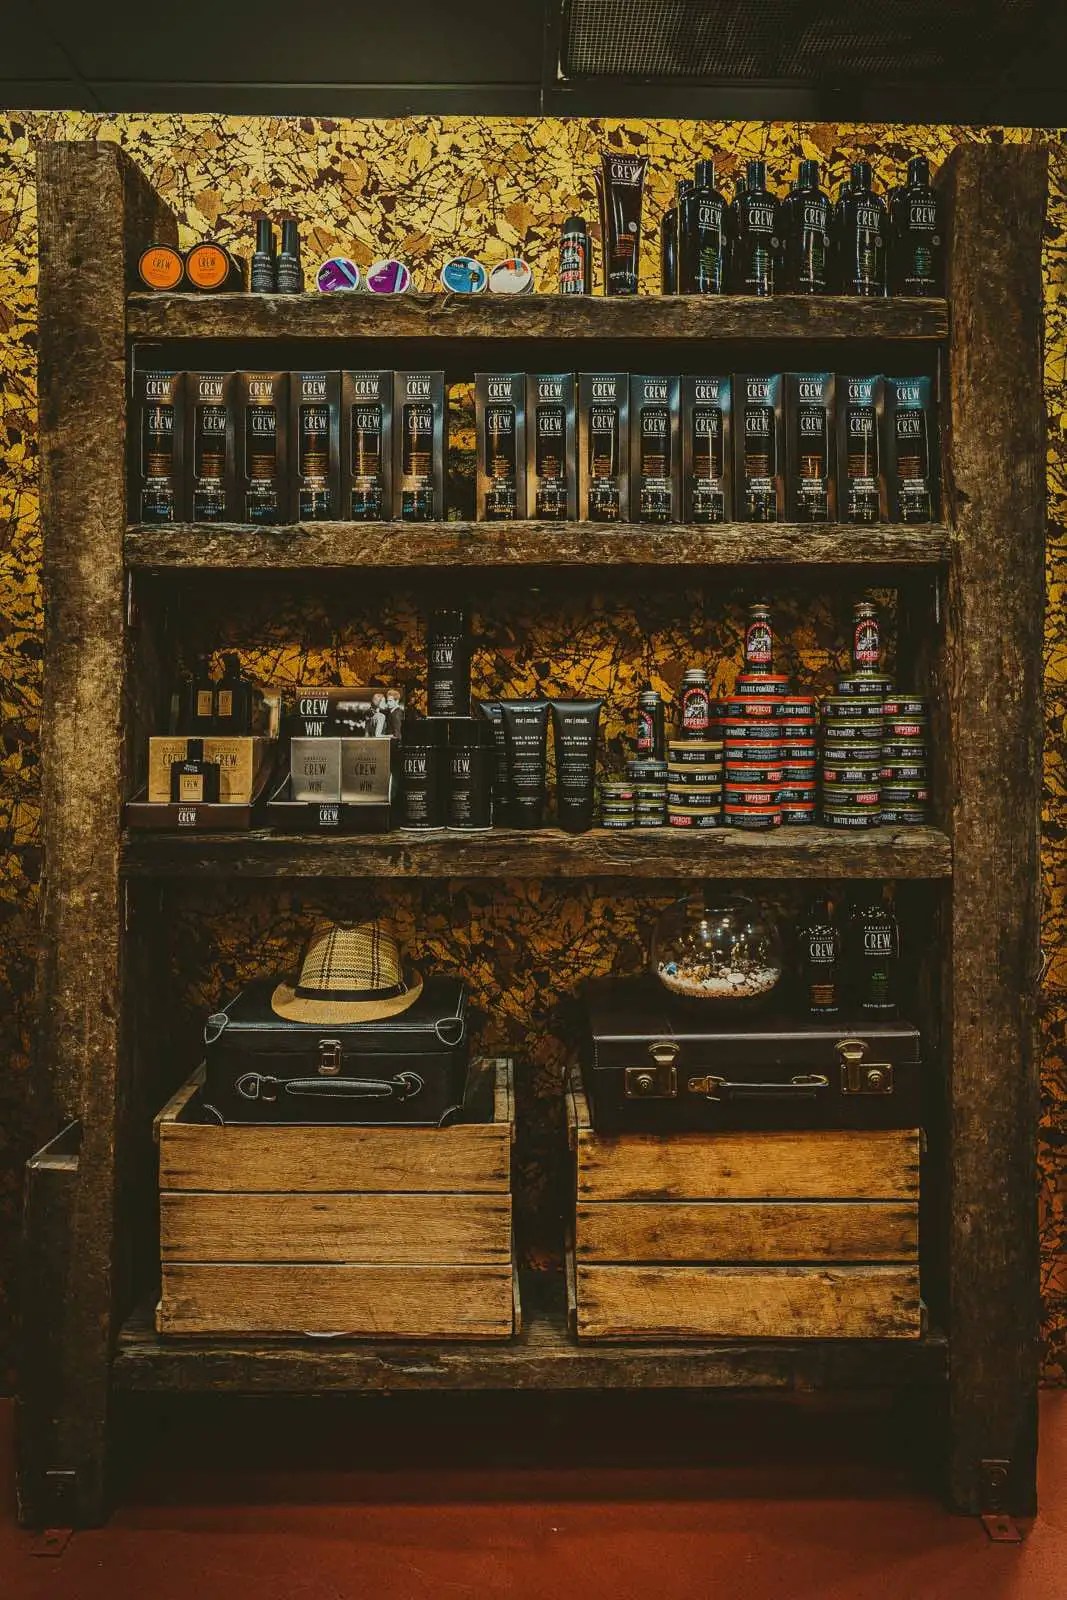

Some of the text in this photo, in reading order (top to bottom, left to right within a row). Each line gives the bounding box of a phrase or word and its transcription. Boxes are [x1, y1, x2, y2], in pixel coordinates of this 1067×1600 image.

[611, 165, 642, 179] CREW
[698, 207, 722, 223] CREW
[748, 210, 774, 226] CREW
[804, 207, 826, 227] CREW
[856, 210, 880, 228] CREW
[910, 207, 936, 223] CREW
[146, 382, 170, 394] CREW
[199, 382, 223, 395] CREW
[249, 382, 273, 395] CREW
[302, 382, 326, 394] CREW
[355, 381, 379, 394] CREW
[407, 381, 431, 394] CREW
[488, 384, 511, 396] CREW
[538, 384, 562, 397] CREW
[592, 384, 616, 396] CREW
[644, 386, 667, 398] CREW
[695, 386, 719, 399] CREW
[747, 384, 770, 397] CREW
[799, 384, 823, 397] CREW
[848, 384, 872, 398] CREW
[896, 388, 920, 400] CREW
[149, 416, 173, 429] CREW
[203, 416, 226, 430] CREW
[252, 417, 276, 430] CREW
[304, 416, 327, 429] CREW
[357, 415, 380, 428] CREW
[408, 416, 432, 428] CREW
[488, 416, 511, 429] CREW
[539, 418, 562, 430] CREW
[592, 416, 614, 428] CREW
[643, 419, 666, 432] CREW
[695, 419, 718, 432] CREW
[746, 418, 769, 431] CREW
[800, 417, 823, 430] CREW
[850, 418, 872, 431] CREW
[897, 420, 920, 432] CREW
[300, 699, 328, 715] CREW
[305, 722, 322, 736] WIN
[215, 755, 237, 766] CREW
[304, 764, 327, 775] CREW
[354, 764, 376, 775] CREW
[178, 813, 196, 822] CREW
[320, 810, 338, 821] CREW
[864, 933, 891, 948] CREW
[810, 943, 834, 957] CREW
